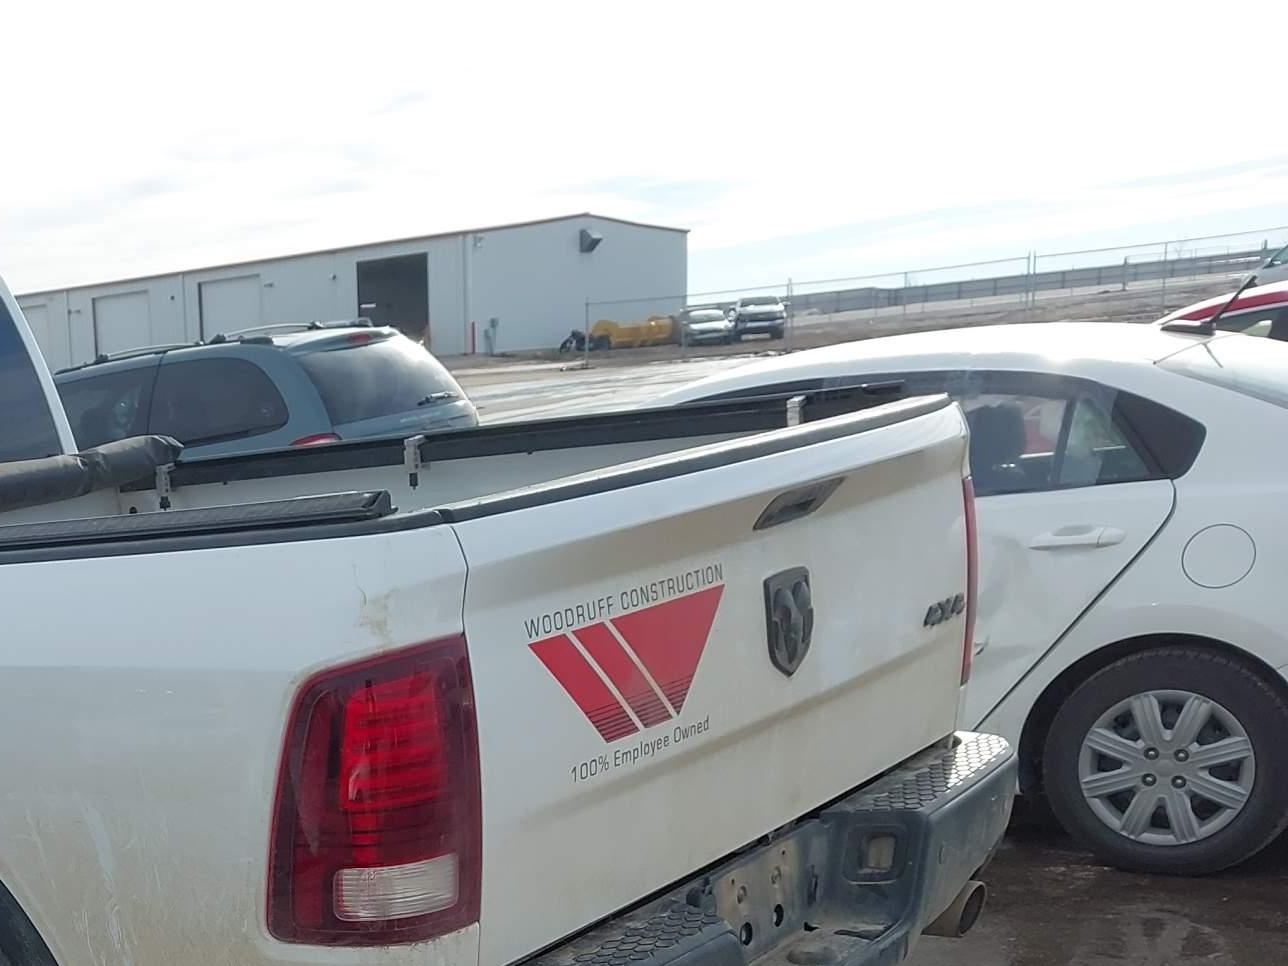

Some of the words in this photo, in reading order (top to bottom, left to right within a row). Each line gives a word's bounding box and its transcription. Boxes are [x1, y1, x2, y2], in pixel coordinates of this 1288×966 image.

[524, 595, 614, 640] WOODRUFF
[620, 563, 724, 610] CONSTRUCTION
[570, 755, 610, 783] 100%
[613, 735, 670, 768] Employee
[673, 715, 710, 743] Owned
